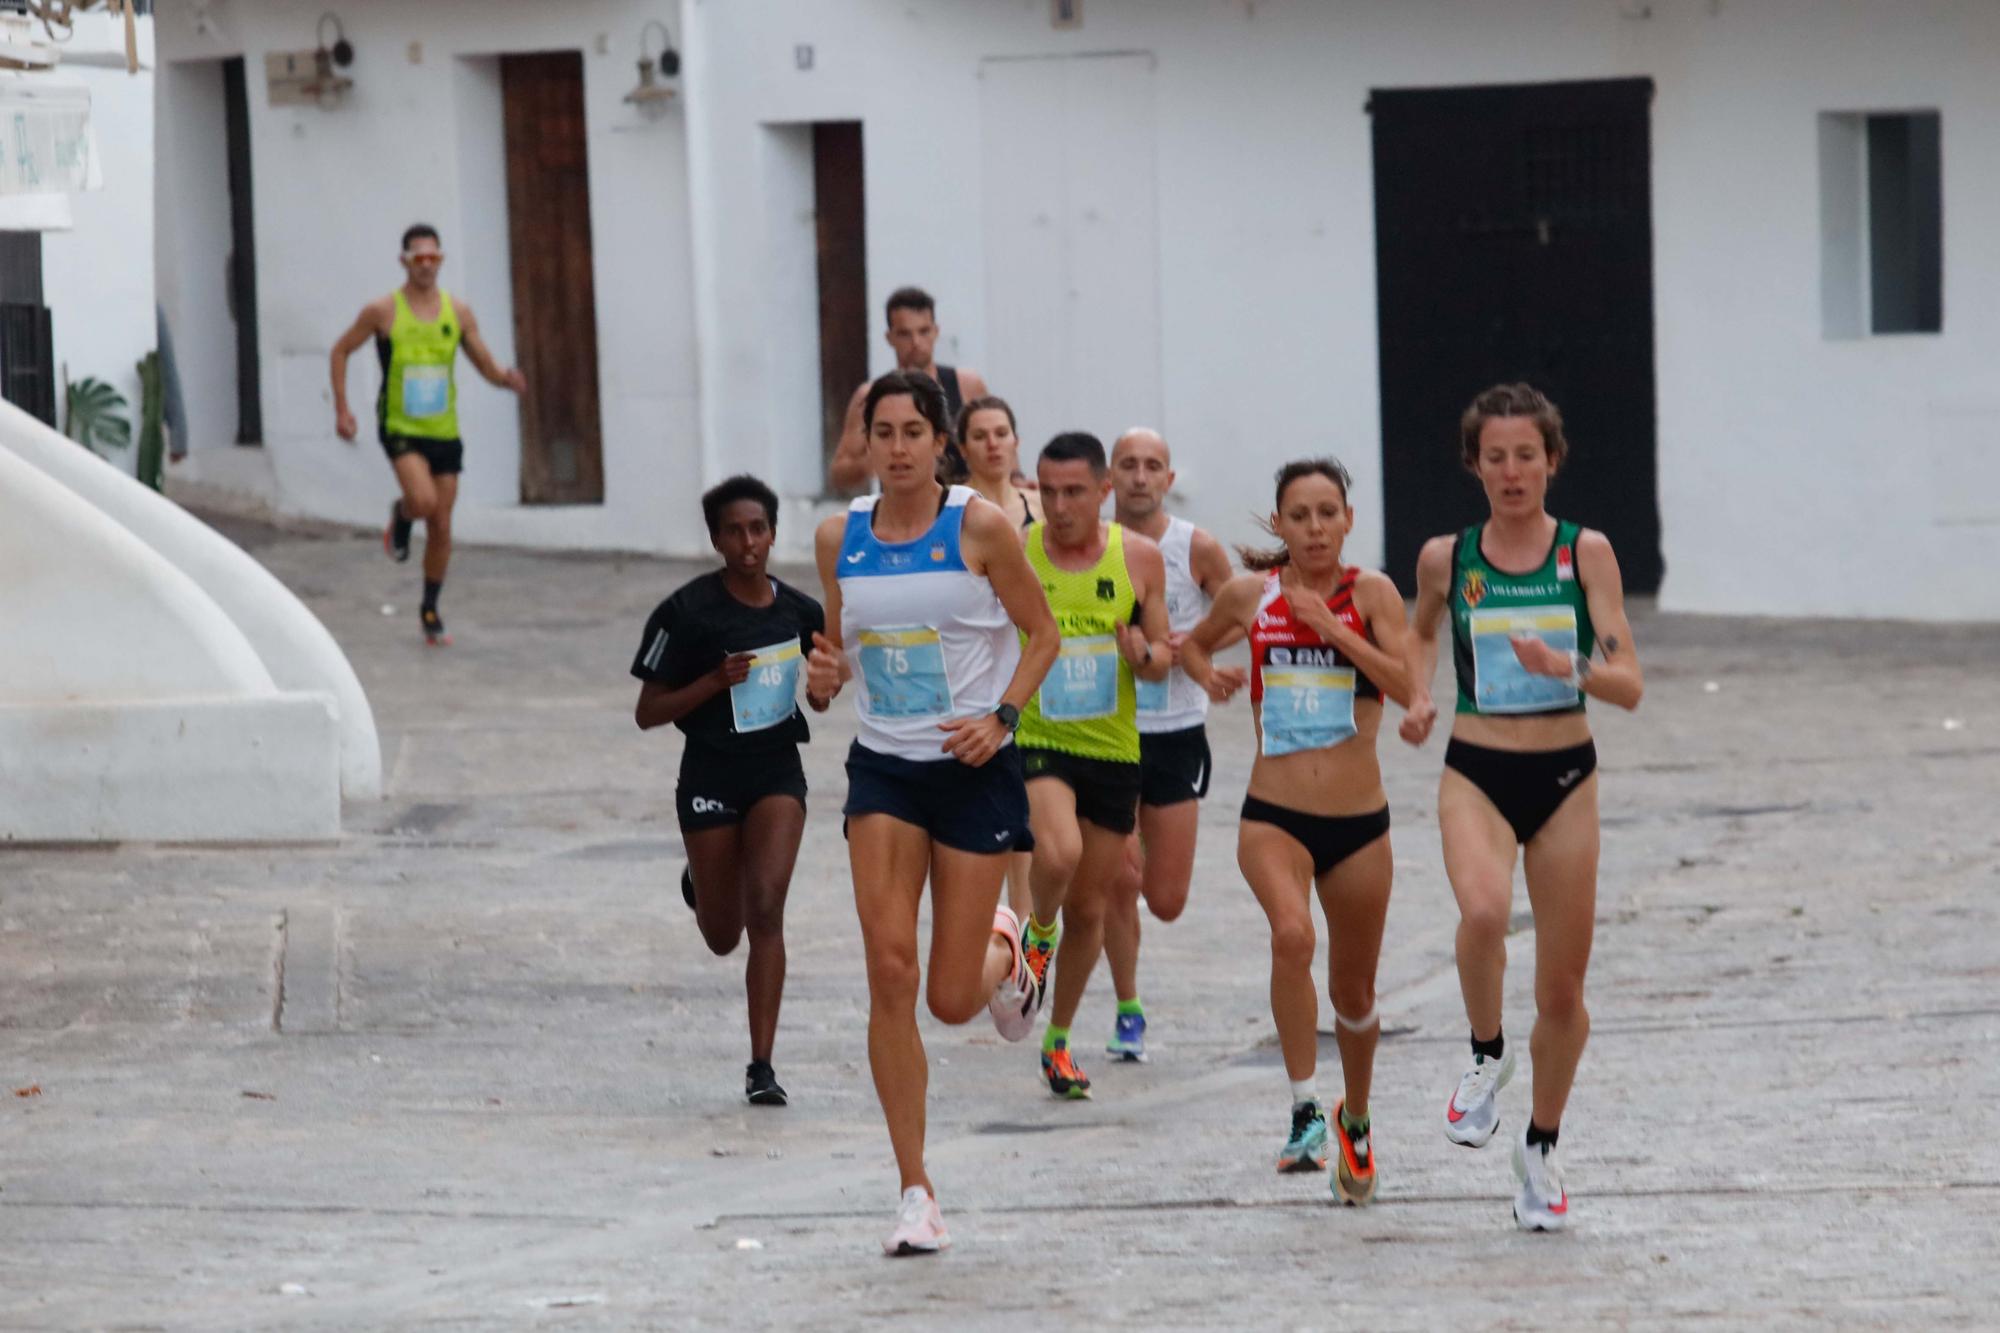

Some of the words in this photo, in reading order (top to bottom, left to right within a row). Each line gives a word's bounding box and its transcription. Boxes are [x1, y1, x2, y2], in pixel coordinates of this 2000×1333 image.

[882, 647, 909, 674] 75
[758, 665, 782, 687] 46
[1291, 686, 1320, 713] 76
